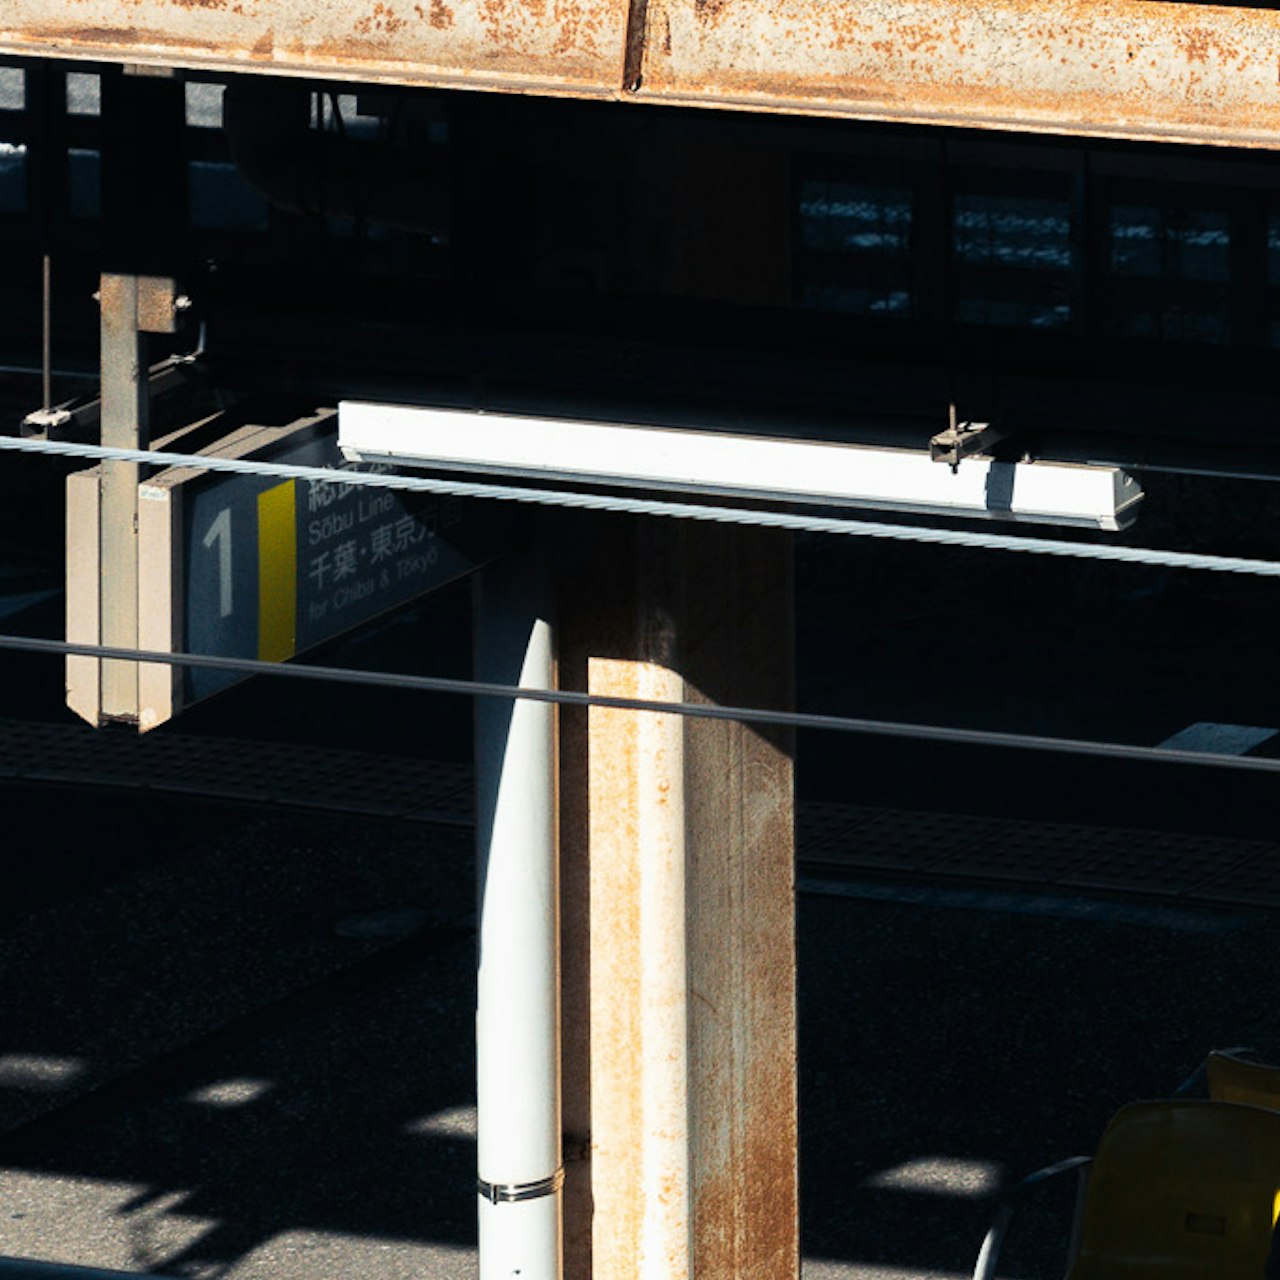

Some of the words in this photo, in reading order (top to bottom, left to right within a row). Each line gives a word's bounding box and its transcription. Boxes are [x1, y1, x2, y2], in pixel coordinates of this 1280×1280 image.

[308, 510, 353, 546] Sōbu
[359, 491, 395, 523] Line
[203, 507, 232, 618] 1
[308, 598, 328, 622] for
[334, 577, 375, 610] Chiba
[380, 568, 390, 589] &
